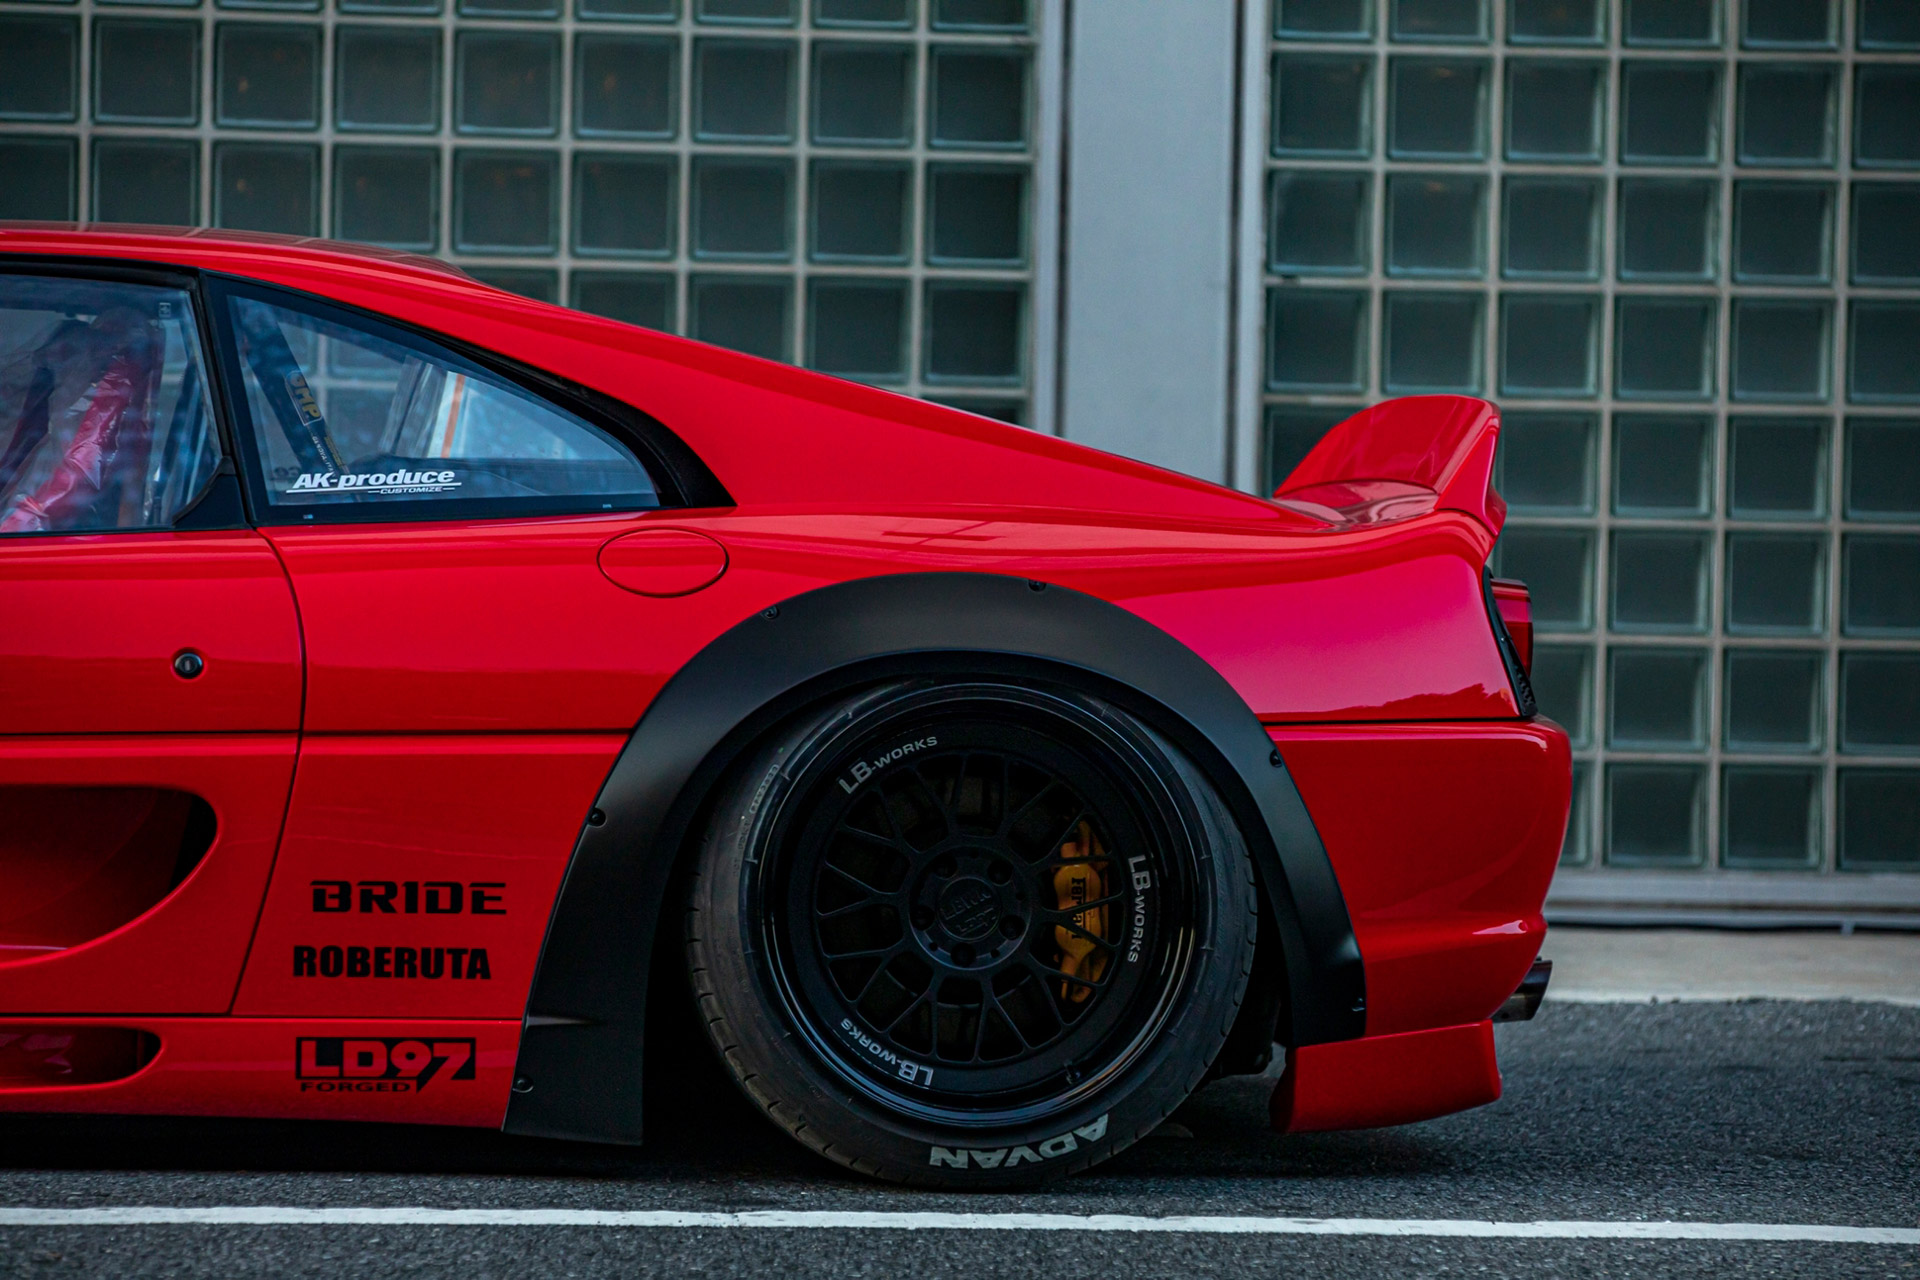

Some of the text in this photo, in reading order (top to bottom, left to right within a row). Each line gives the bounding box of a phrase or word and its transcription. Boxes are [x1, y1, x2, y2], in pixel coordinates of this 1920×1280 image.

[289, 373, 321, 418] OMP
[292, 469, 455, 489] AK-produce
[380, 486, 443, 494] CUSTOMIZE
[839, 736, 938, 794] LB-WORKS
[310, 880, 507, 915] BRIDE
[1127, 854, 1151, 963] LB-WORKS
[293, 945, 491, 980] ROBERUTA
[299, 1038, 473, 1080] LD97
[840, 1018, 934, 1086] LB-WORKS
[301, 1082, 411, 1093] FORGED
[929, 1113, 1109, 1168] ADVAN
